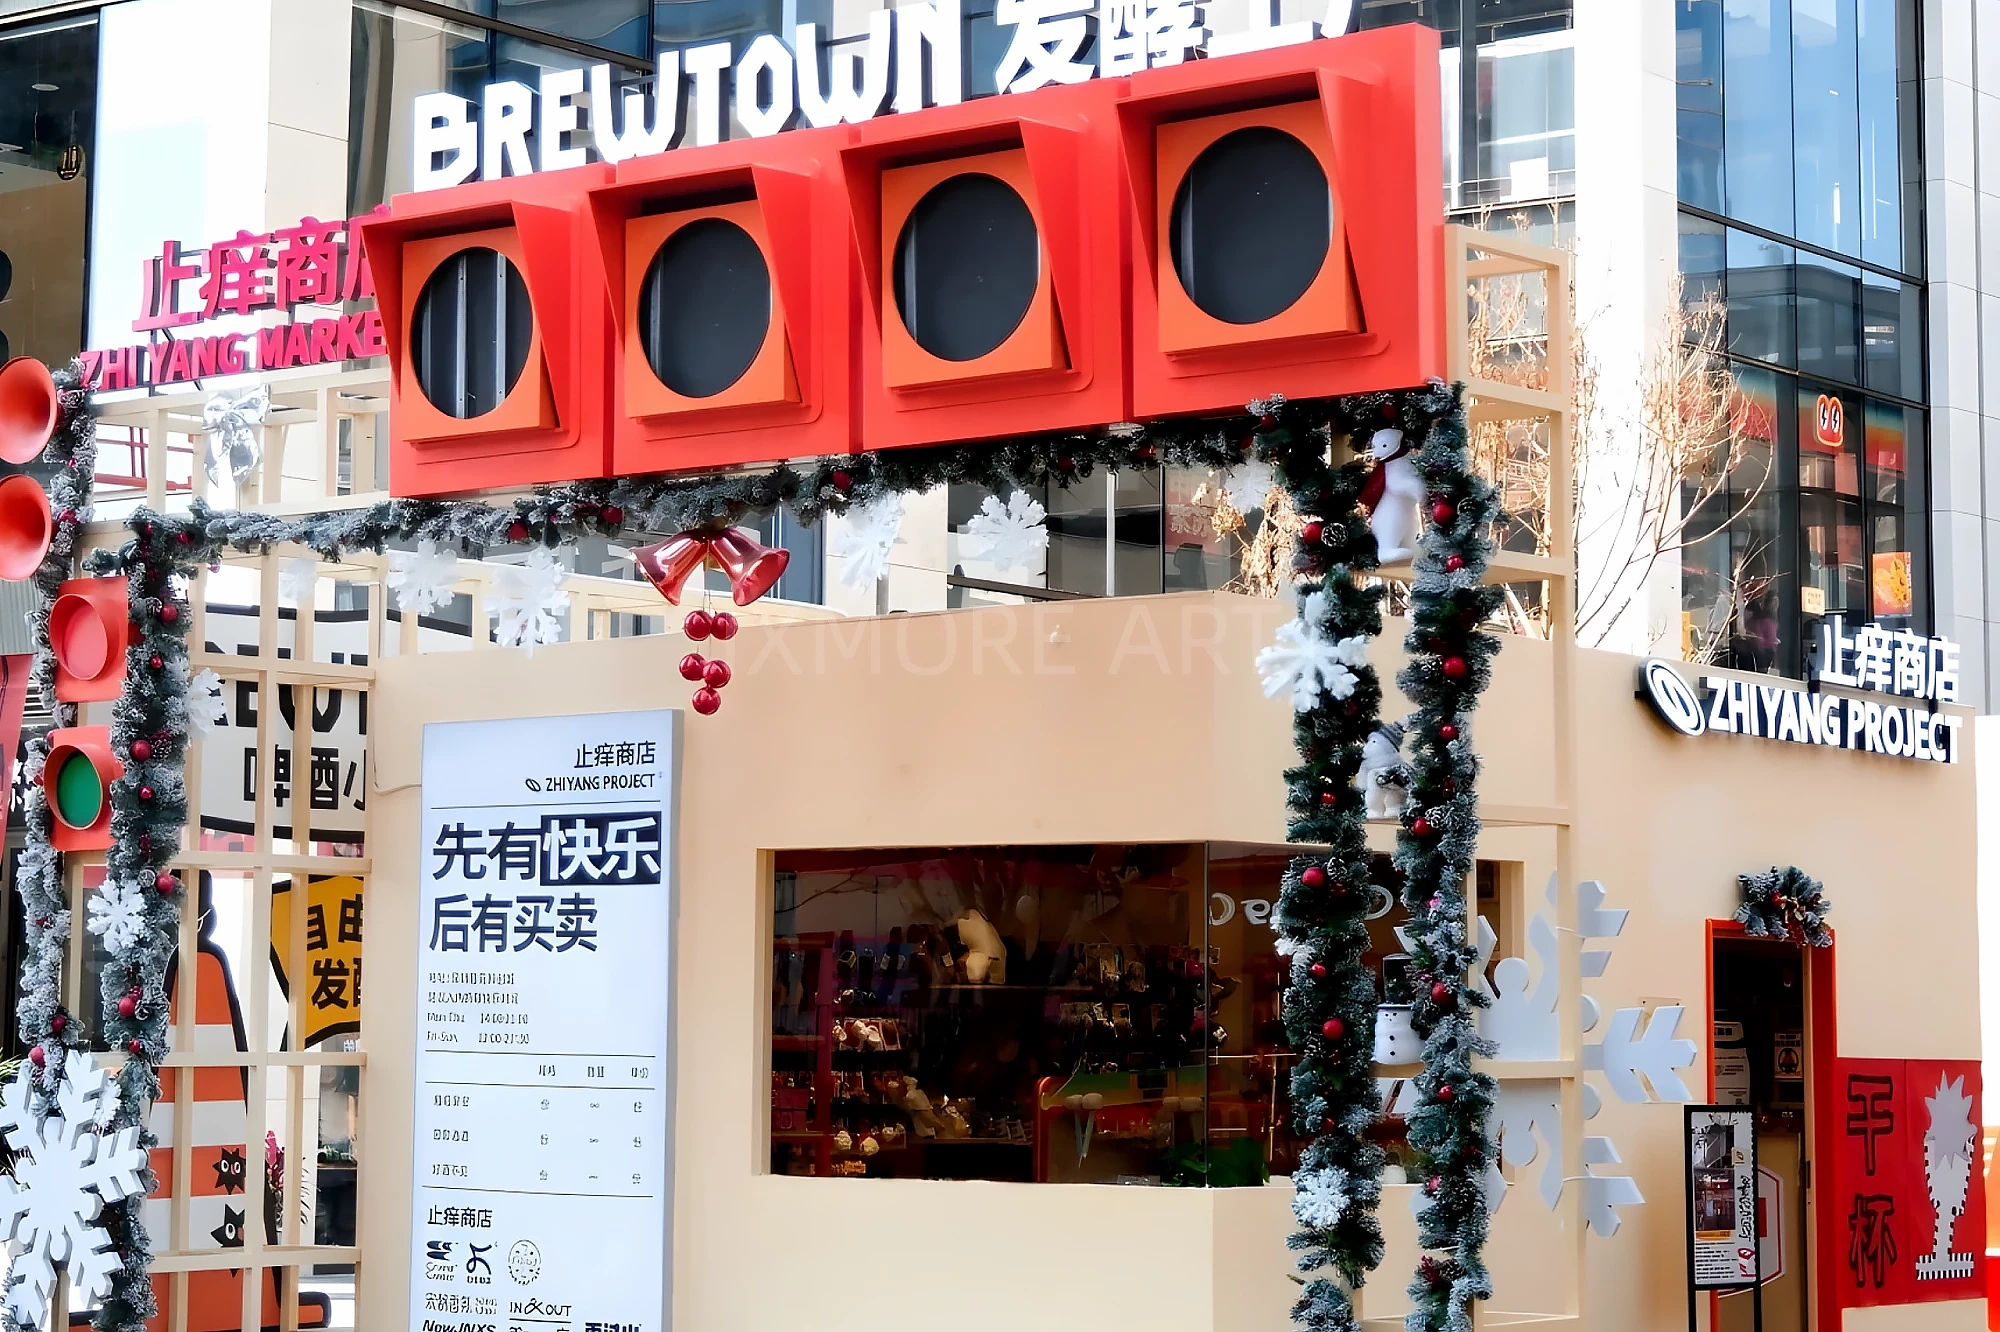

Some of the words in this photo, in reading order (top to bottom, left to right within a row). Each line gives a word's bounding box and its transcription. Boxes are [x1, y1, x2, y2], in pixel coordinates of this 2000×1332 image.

[413, 0, 962, 194] BREWTOWN
[255, 310, 390, 370] MARKE
[1819, 614, 1961, 703] 止痒商店
[1706, 676, 1842, 747] ZHIYANG
[1847, 698, 1963, 764] PROJECT
[545, 776, 600, 792] ZHIYANG
[603, 774, 656, 790] PROJECT
[574, 740, 656, 769] 止痒商店
[432, 816, 661, 881] 先有快乐
[429, 891, 598, 953] 后有买卖
[311, 955, 362, 1011] 发
[1846, 1073, 1898, 1289] 干杯
[428, 1204, 493, 1229] 止痒商店
